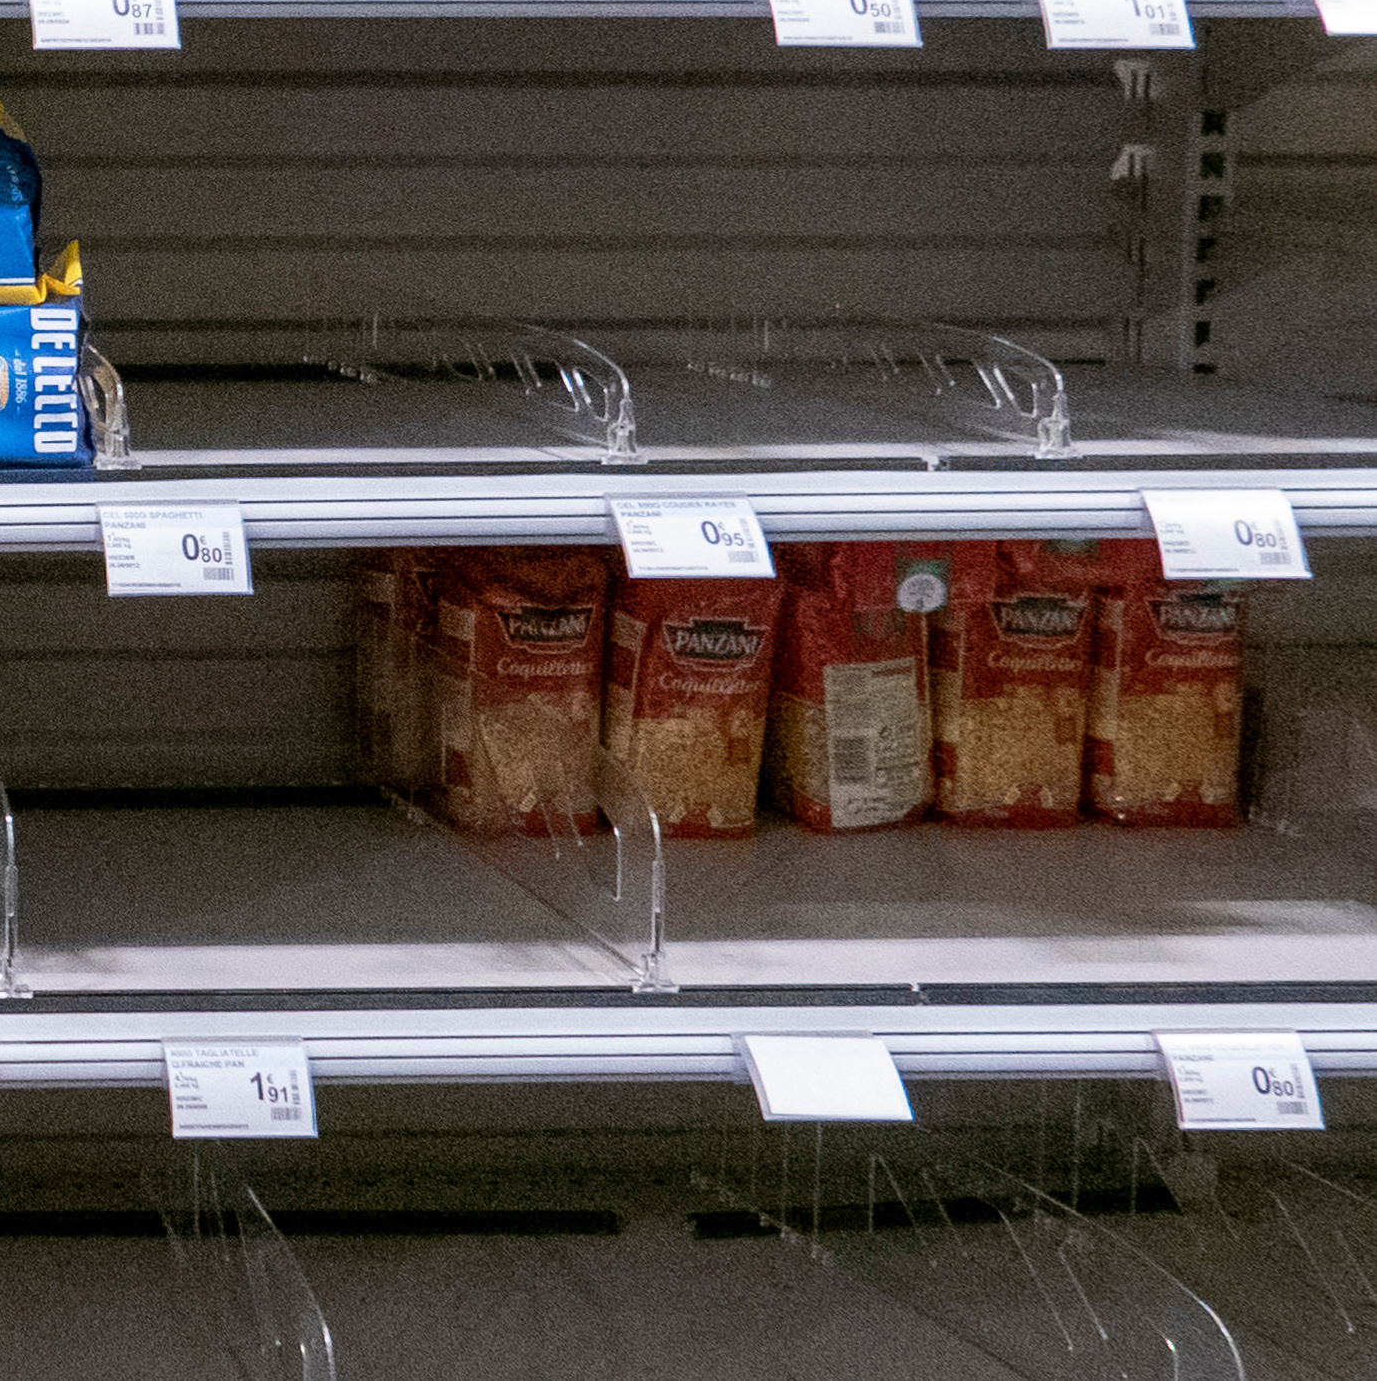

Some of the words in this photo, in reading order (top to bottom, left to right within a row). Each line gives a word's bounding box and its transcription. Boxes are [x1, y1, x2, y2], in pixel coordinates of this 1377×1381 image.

[30, 308, 78, 350] DE
[13, 358, 26, 376] dal
[15, 377, 27, 404] 1886
[32, 356, 78, 454] CECCO
[103, 511, 121, 519] CEL
[149, 511, 203, 519] SPAGHETTI
[676, 631, 758, 654] PANZANI
[195, 1049, 258, 1058] TAGLIATELLE
[224, 1060, 245, 1068] PAN
